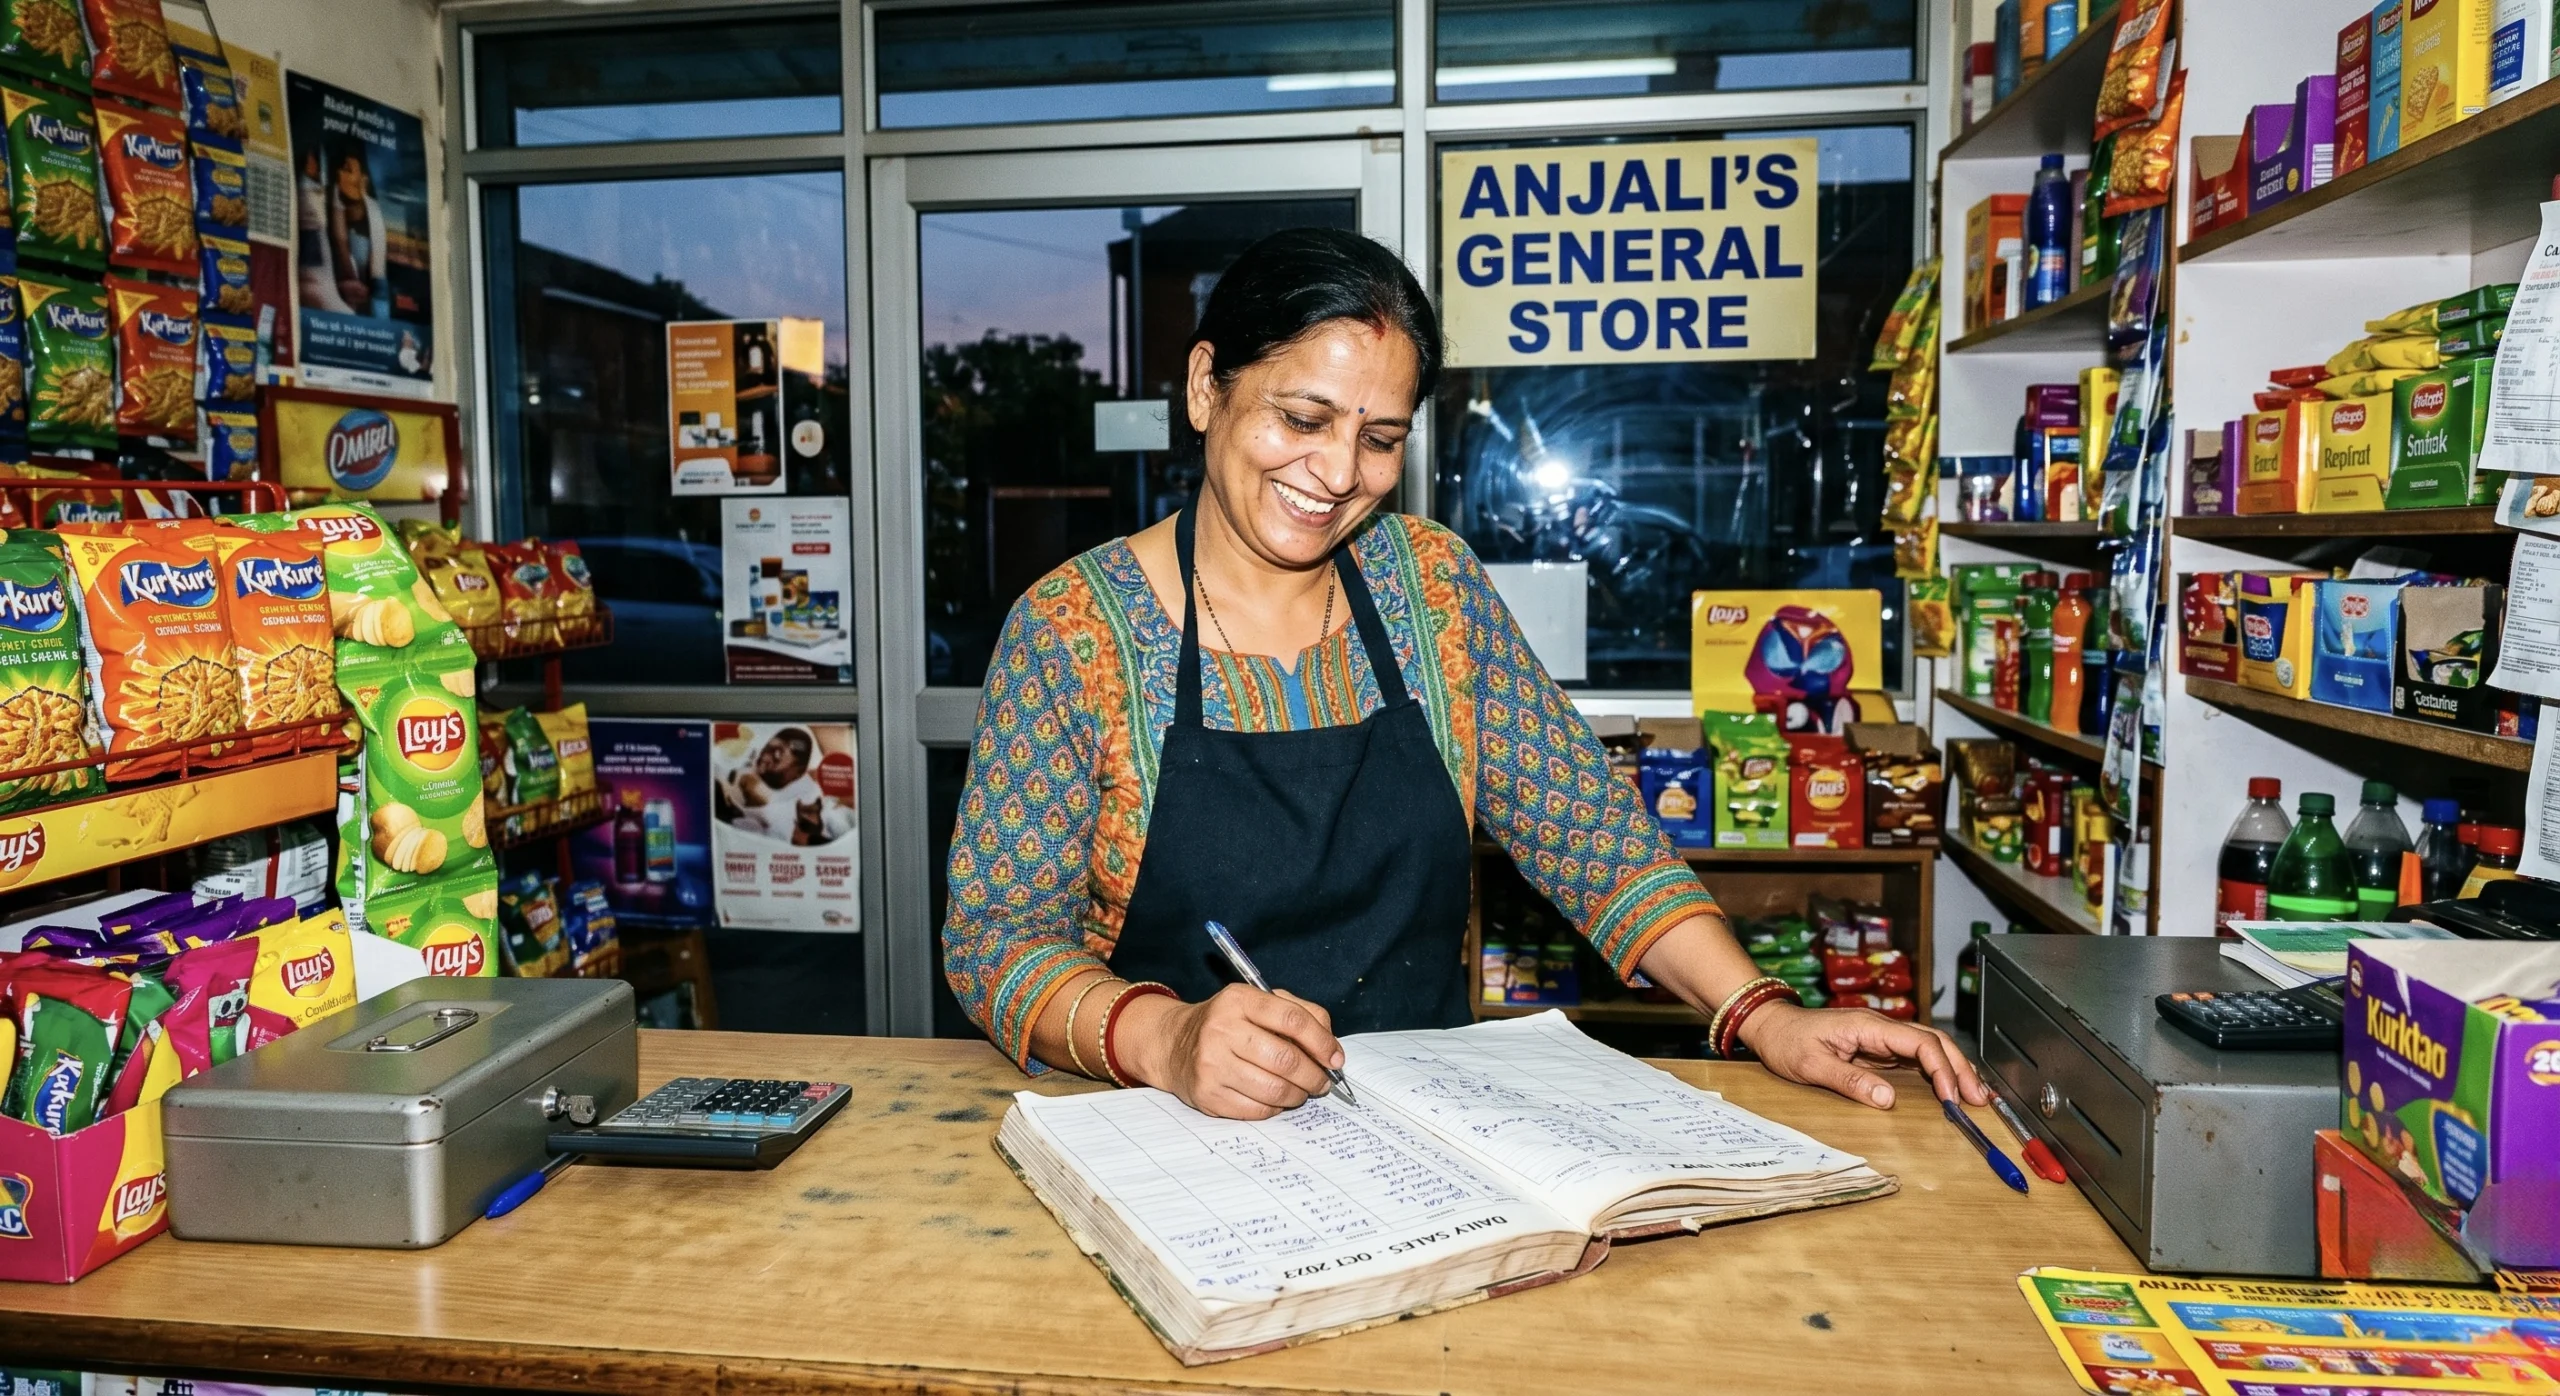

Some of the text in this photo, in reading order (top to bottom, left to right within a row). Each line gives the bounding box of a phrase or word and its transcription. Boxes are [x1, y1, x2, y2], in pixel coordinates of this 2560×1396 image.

[1460, 153, 1799, 219] ANJALI'S
[1456, 225, 1804, 288] GENERAL
[1508, 295, 1748, 354] STORE
[120, 561, 217, 605] Kurkure
[236, 557, 324, 598] Kurkure
[403, 712, 461, 755] Lay's
[116, 1169, 166, 1224] Lay's
[1388, 1229, 1450, 1255] SALES
[1455, 1215, 1508, 1236] DAILY
[1336, 1252, 1373, 1267] OCT
[2138, 1279, 2235, 1293] ANJALI'S
